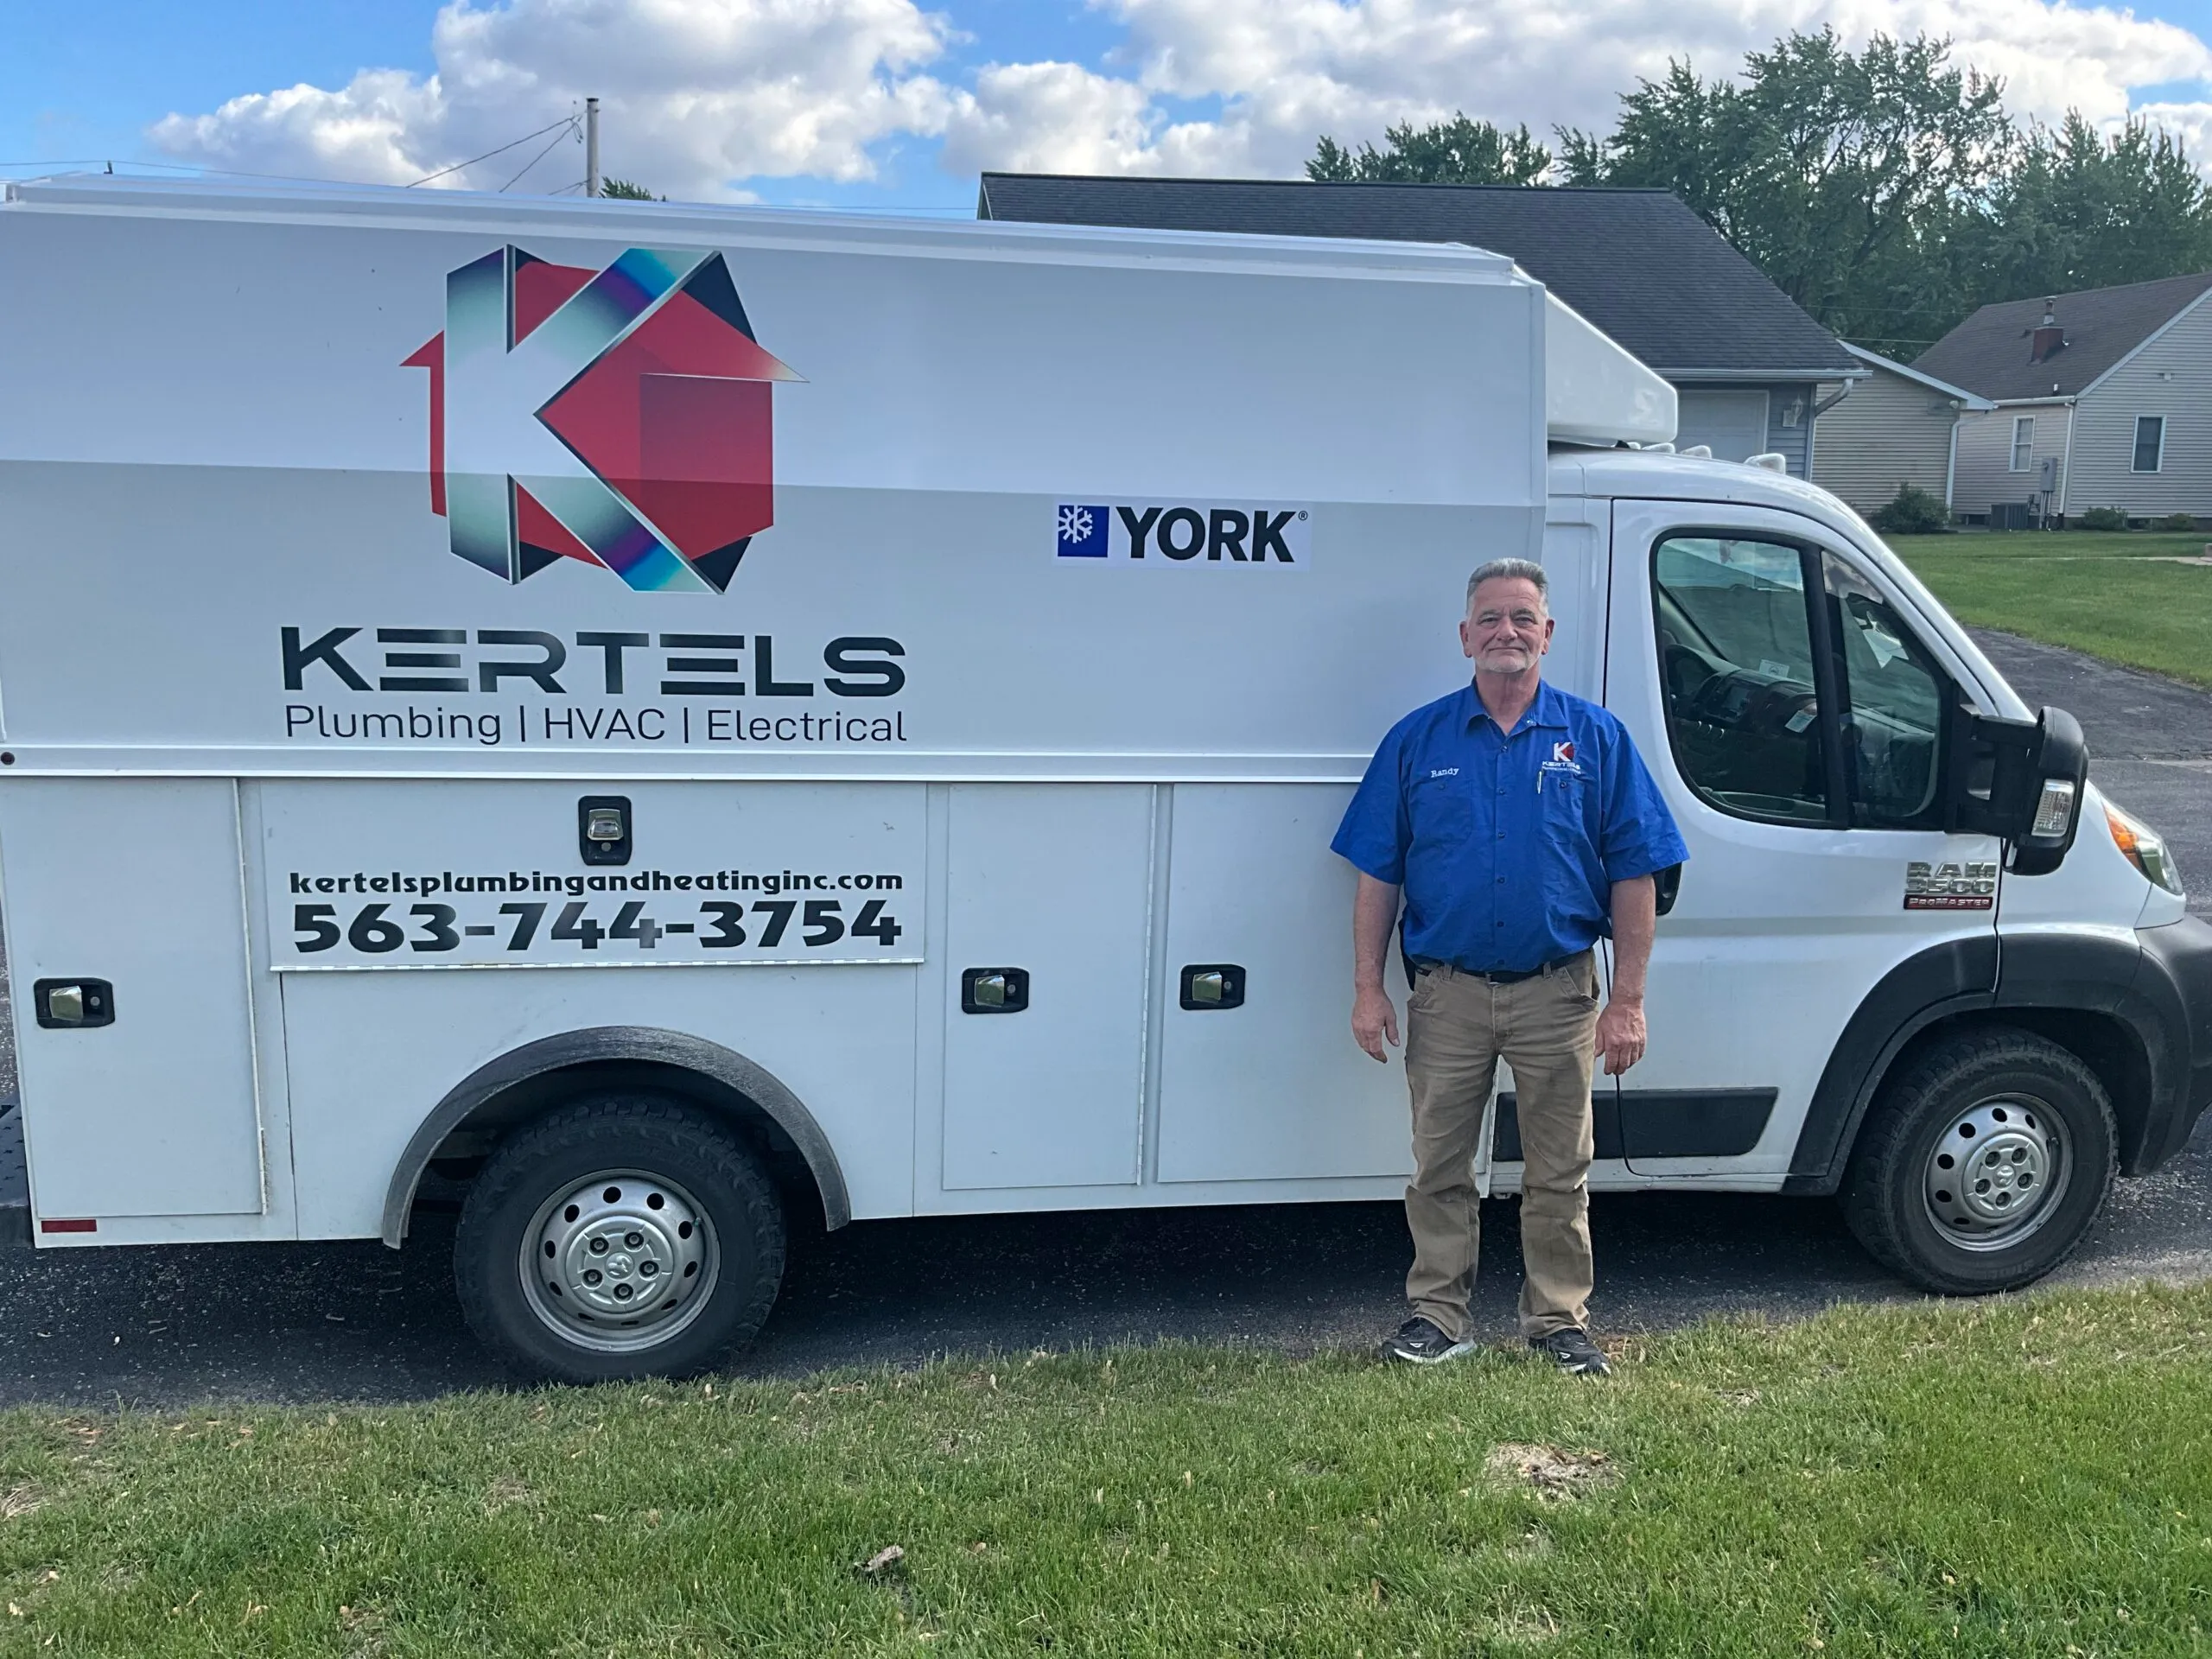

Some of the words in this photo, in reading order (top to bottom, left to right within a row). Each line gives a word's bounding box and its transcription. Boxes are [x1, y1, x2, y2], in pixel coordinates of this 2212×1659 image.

[281, 626, 906, 696] KERTELS
[286, 705, 501, 745] Plumbing
[544, 708, 665, 741] HVAC
[708, 710, 906, 742] Electrical
[1430, 767, 1459, 778] Randy
[289, 871, 903, 896] kertelsplumbingandheatinginc.com
[1907, 861, 1997, 878] RAM
[294, 899, 903, 953] 563-744-3754
